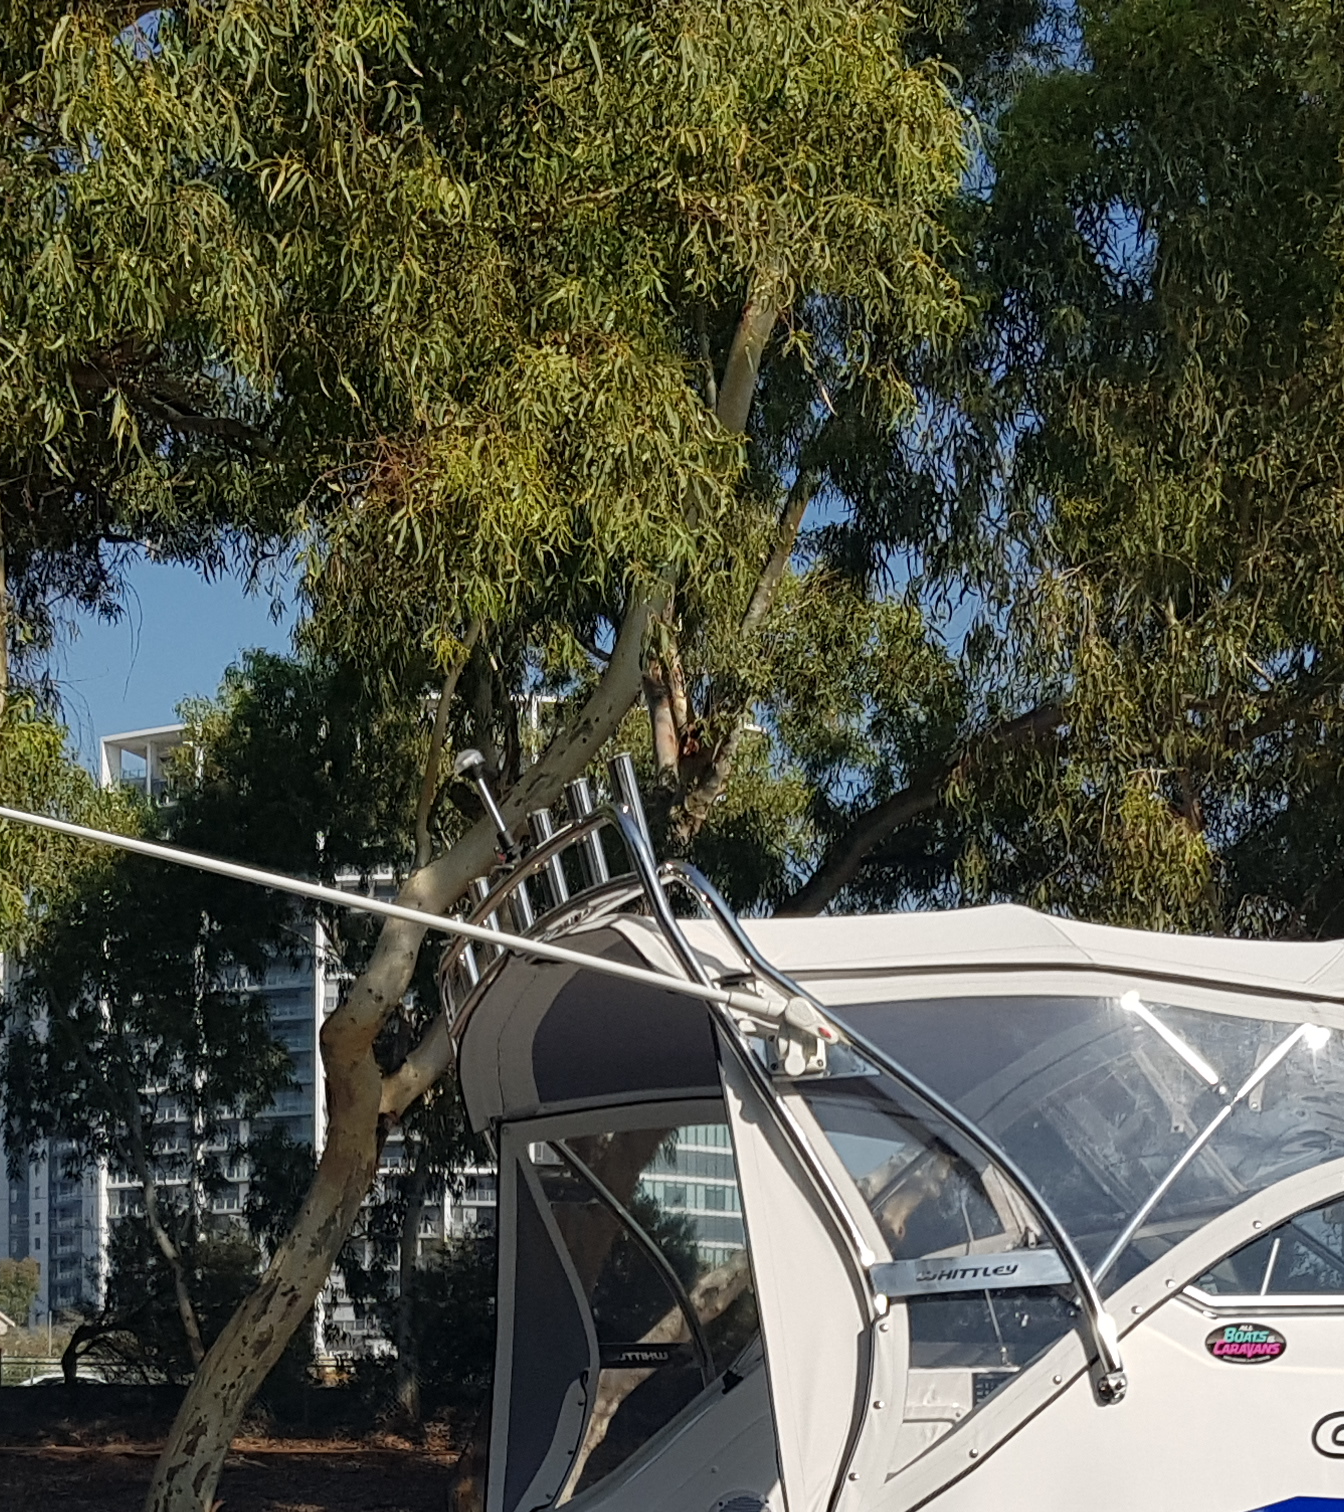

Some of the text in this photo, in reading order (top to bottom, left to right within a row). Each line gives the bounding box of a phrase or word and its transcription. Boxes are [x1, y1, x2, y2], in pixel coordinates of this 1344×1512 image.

[916, 1264, 1019, 1283] WHITTLEY
[1224, 1327, 1270, 1343] BOATS
[1213, 1340, 1281, 1358] CARAVANS
